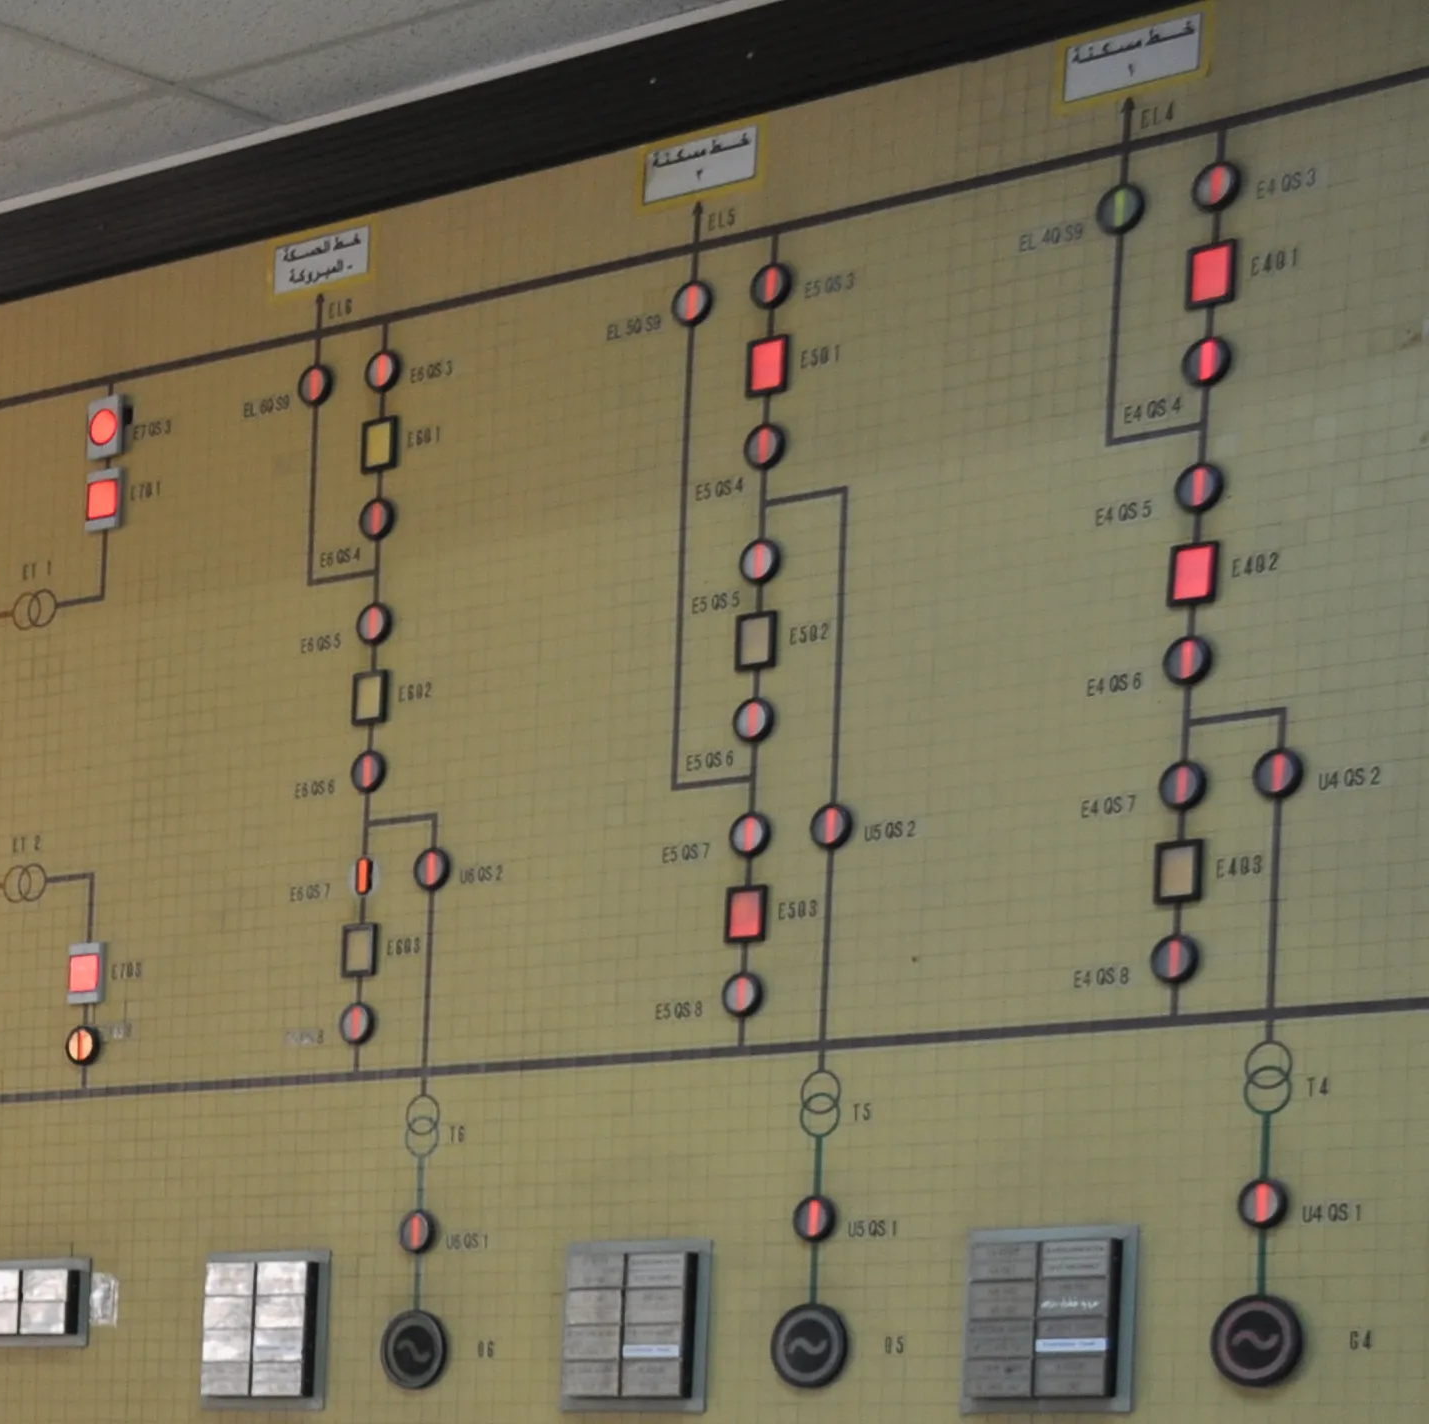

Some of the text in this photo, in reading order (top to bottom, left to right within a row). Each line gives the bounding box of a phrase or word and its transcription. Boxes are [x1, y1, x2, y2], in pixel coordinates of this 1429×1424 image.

[1141, 102, 1174, 129] EL4
[708, 208, 735, 231] EL5
[1232, 552, 1280, 578] E4Q2
[1217, 855, 1262, 878] E4Q3
